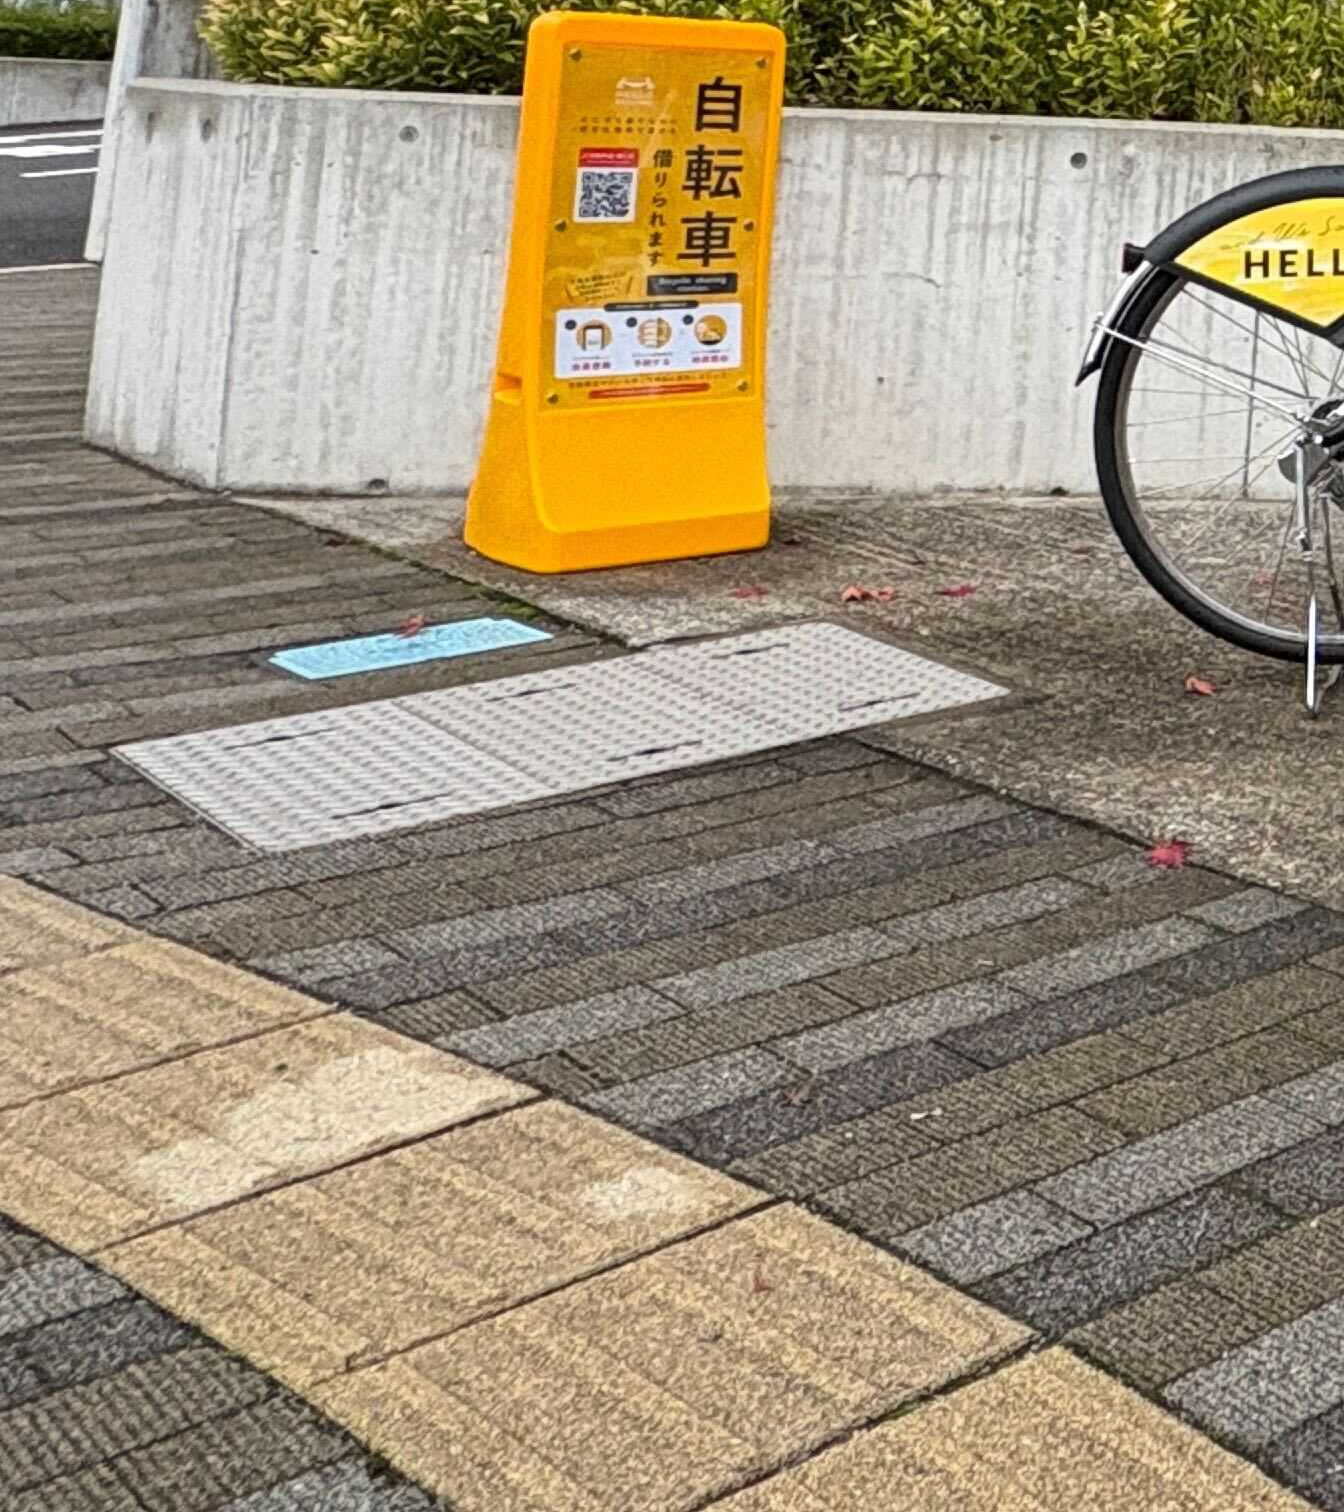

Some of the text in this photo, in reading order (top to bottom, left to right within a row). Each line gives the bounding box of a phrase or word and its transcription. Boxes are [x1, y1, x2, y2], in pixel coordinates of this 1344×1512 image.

[648, 149, 673, 266] 借りられます
[676, 76, 743, 267] 自転車
